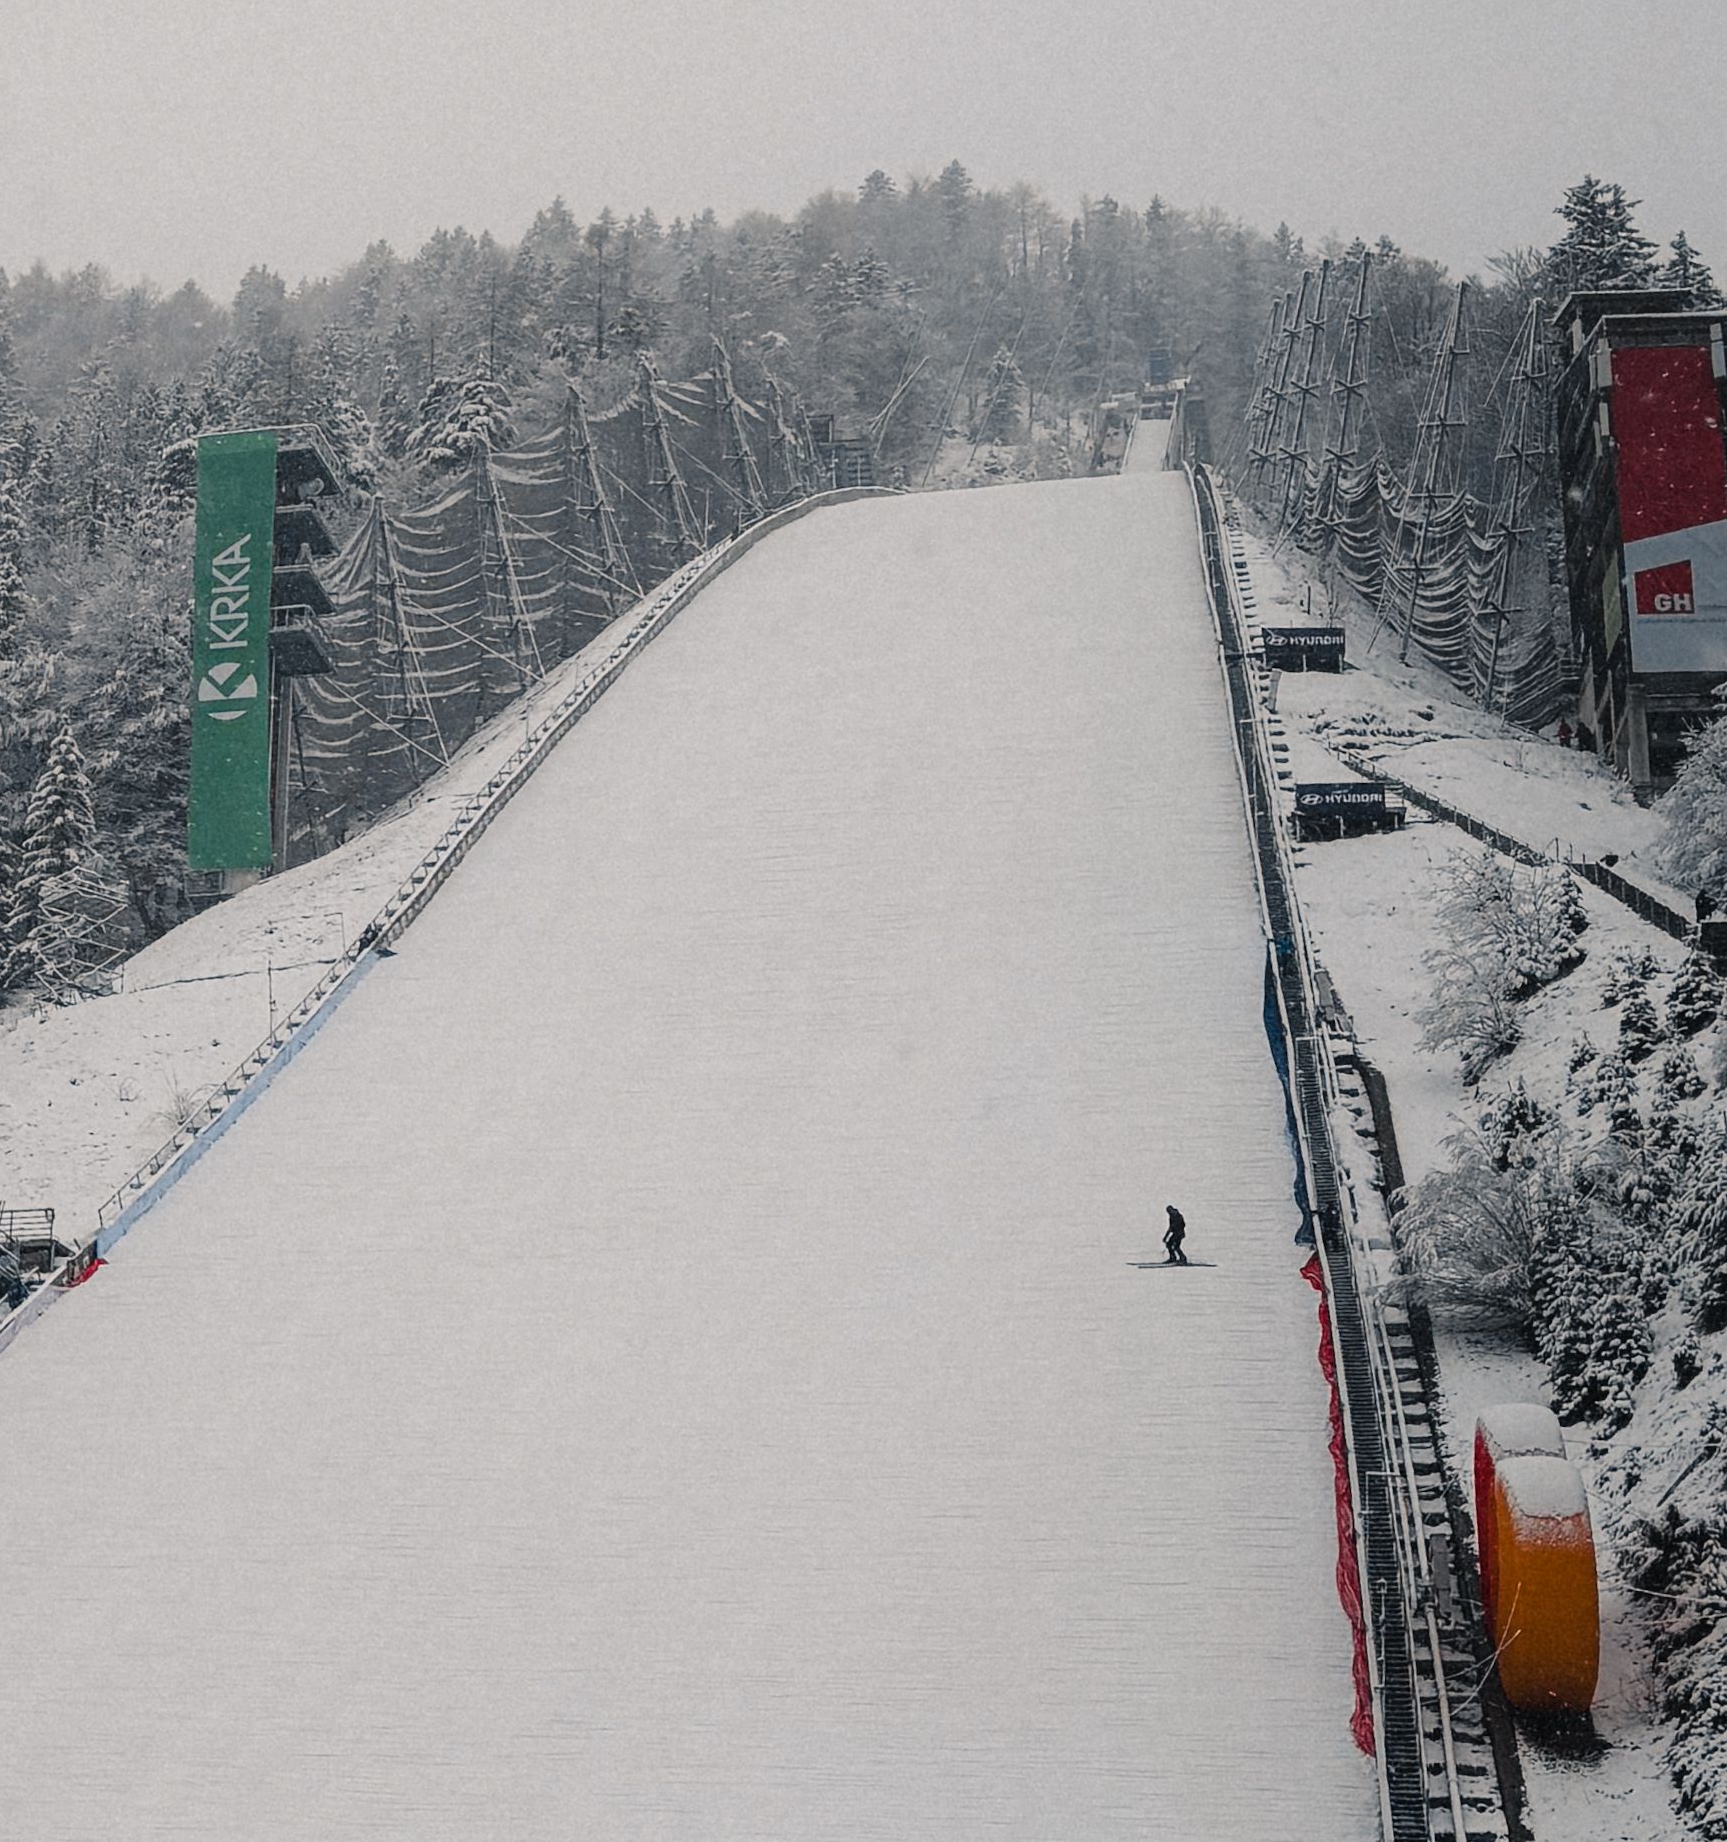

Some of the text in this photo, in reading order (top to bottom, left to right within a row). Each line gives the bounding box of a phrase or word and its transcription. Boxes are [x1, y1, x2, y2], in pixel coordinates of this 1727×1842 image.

[209, 533, 251, 649] KRKA
[1654, 593, 1692, 612] GH
[1290, 635, 1344, 646] HYUNDAI
[1325, 793, 1383, 803] HYUNDAI
